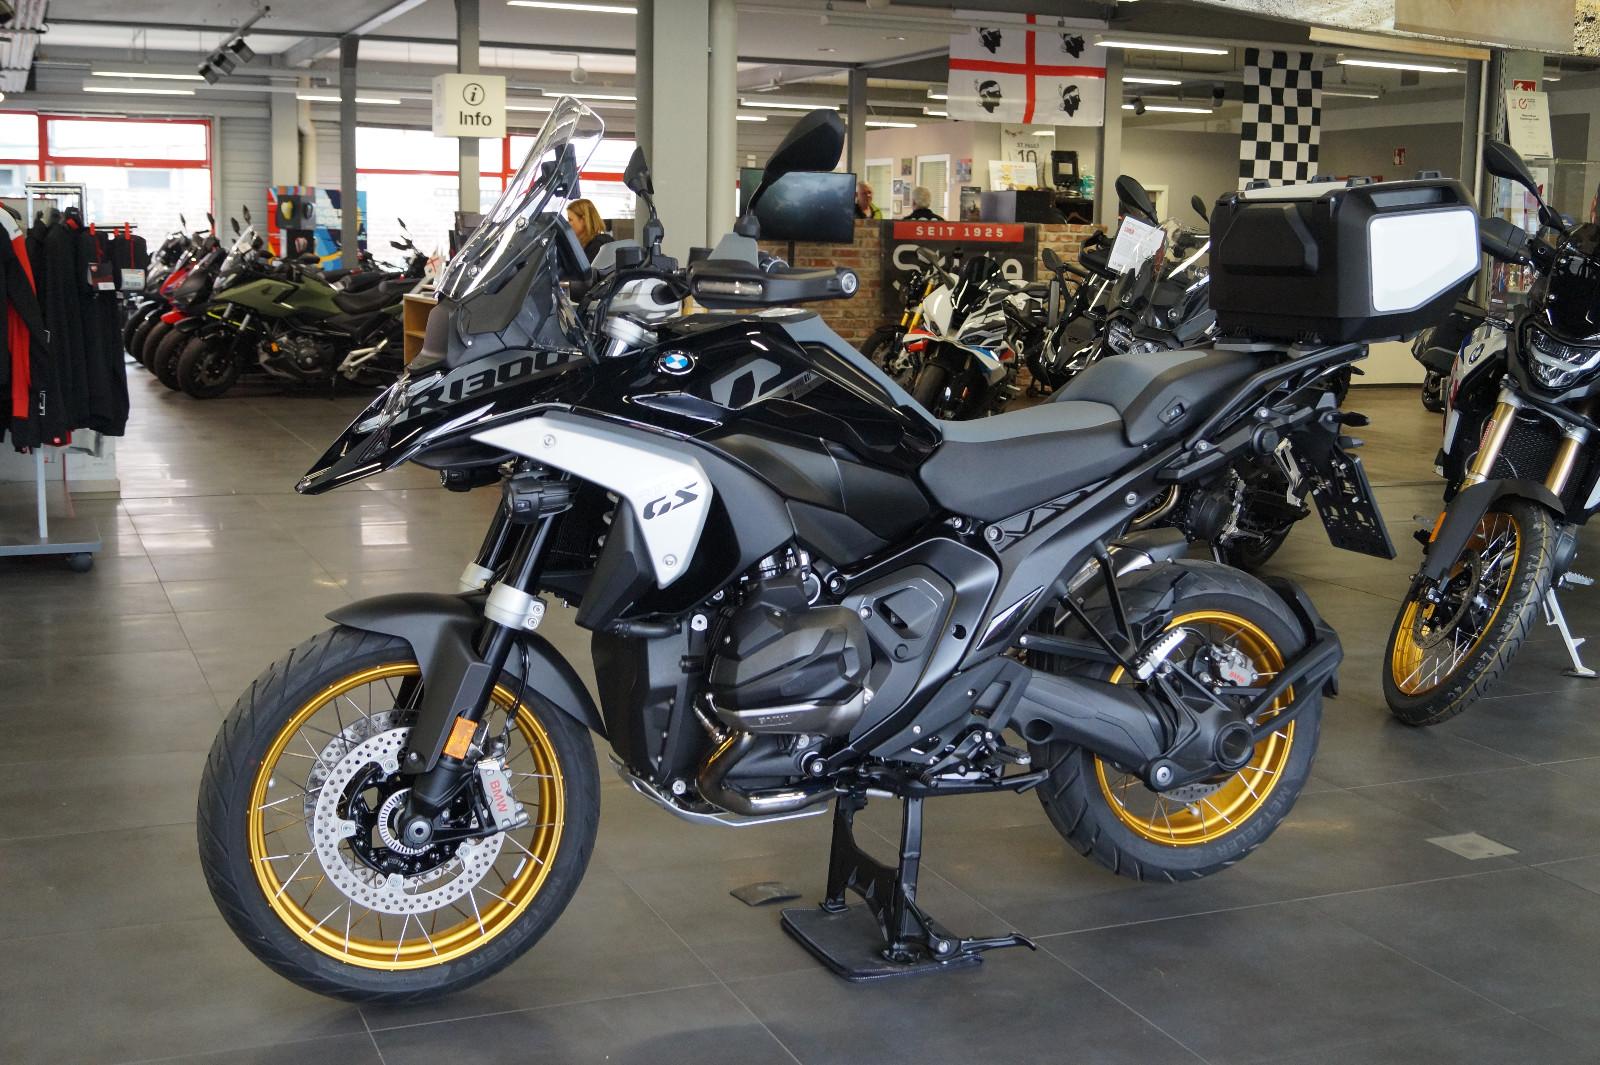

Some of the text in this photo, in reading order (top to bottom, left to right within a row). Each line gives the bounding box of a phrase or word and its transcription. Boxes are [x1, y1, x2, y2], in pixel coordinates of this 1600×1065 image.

[459, 111, 492, 127] Info
[916, 226, 1004, 238] SEIT 1925
[643, 481, 699, 520] GS
[490, 780, 508, 813] BMW
